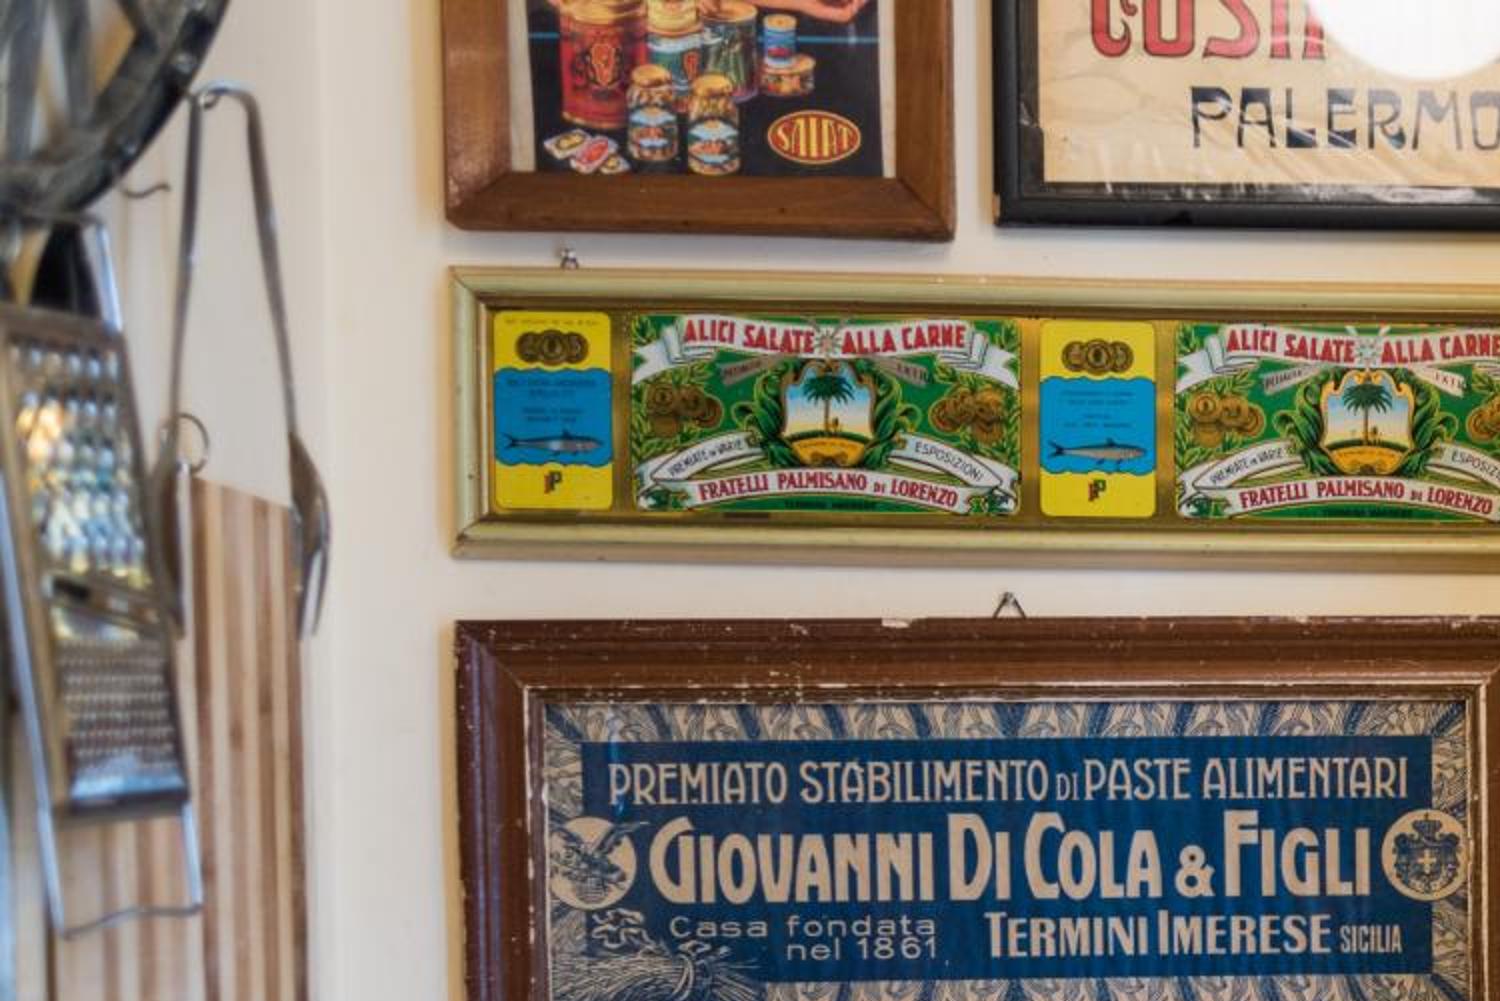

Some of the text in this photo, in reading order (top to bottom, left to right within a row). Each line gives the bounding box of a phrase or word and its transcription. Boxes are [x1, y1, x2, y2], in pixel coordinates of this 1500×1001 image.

[682, 319, 967, 354] ALICI SALATE ALLA CARNE
[1226, 328, 1278, 353] ALICI
[1283, 333, 1356, 363] SALATE
[1380, 336, 1436, 364] ALLA
[914, 441, 984, 482] ESPOSIZIONI
[697, 474, 769, 501] FRATELLI
[776, 469, 867, 492] PALMISANO
[890, 478, 959, 507] LORENZO
[1238, 482, 1309, 510] FRATELLI
[1315, 478, 1406, 499] PALMISANO
[1427, 486, 1493, 515] LORENZO
[608, 762, 788, 804] PREMIATO
[799, 759, 1049, 803] STABILIMENTO
[1084, 758, 1191, 800] PASTE
[1202, 757, 1408, 799] ALIMENTARI
[649, 809, 1371, 904] GIOVANNI DI COLA & FIGLI
[669, 914, 937, 939] Casa fondata
[983, 909, 1404, 958] TERMINI IMERESE SICILIA
[786, 937, 937, 960] nel 1861
